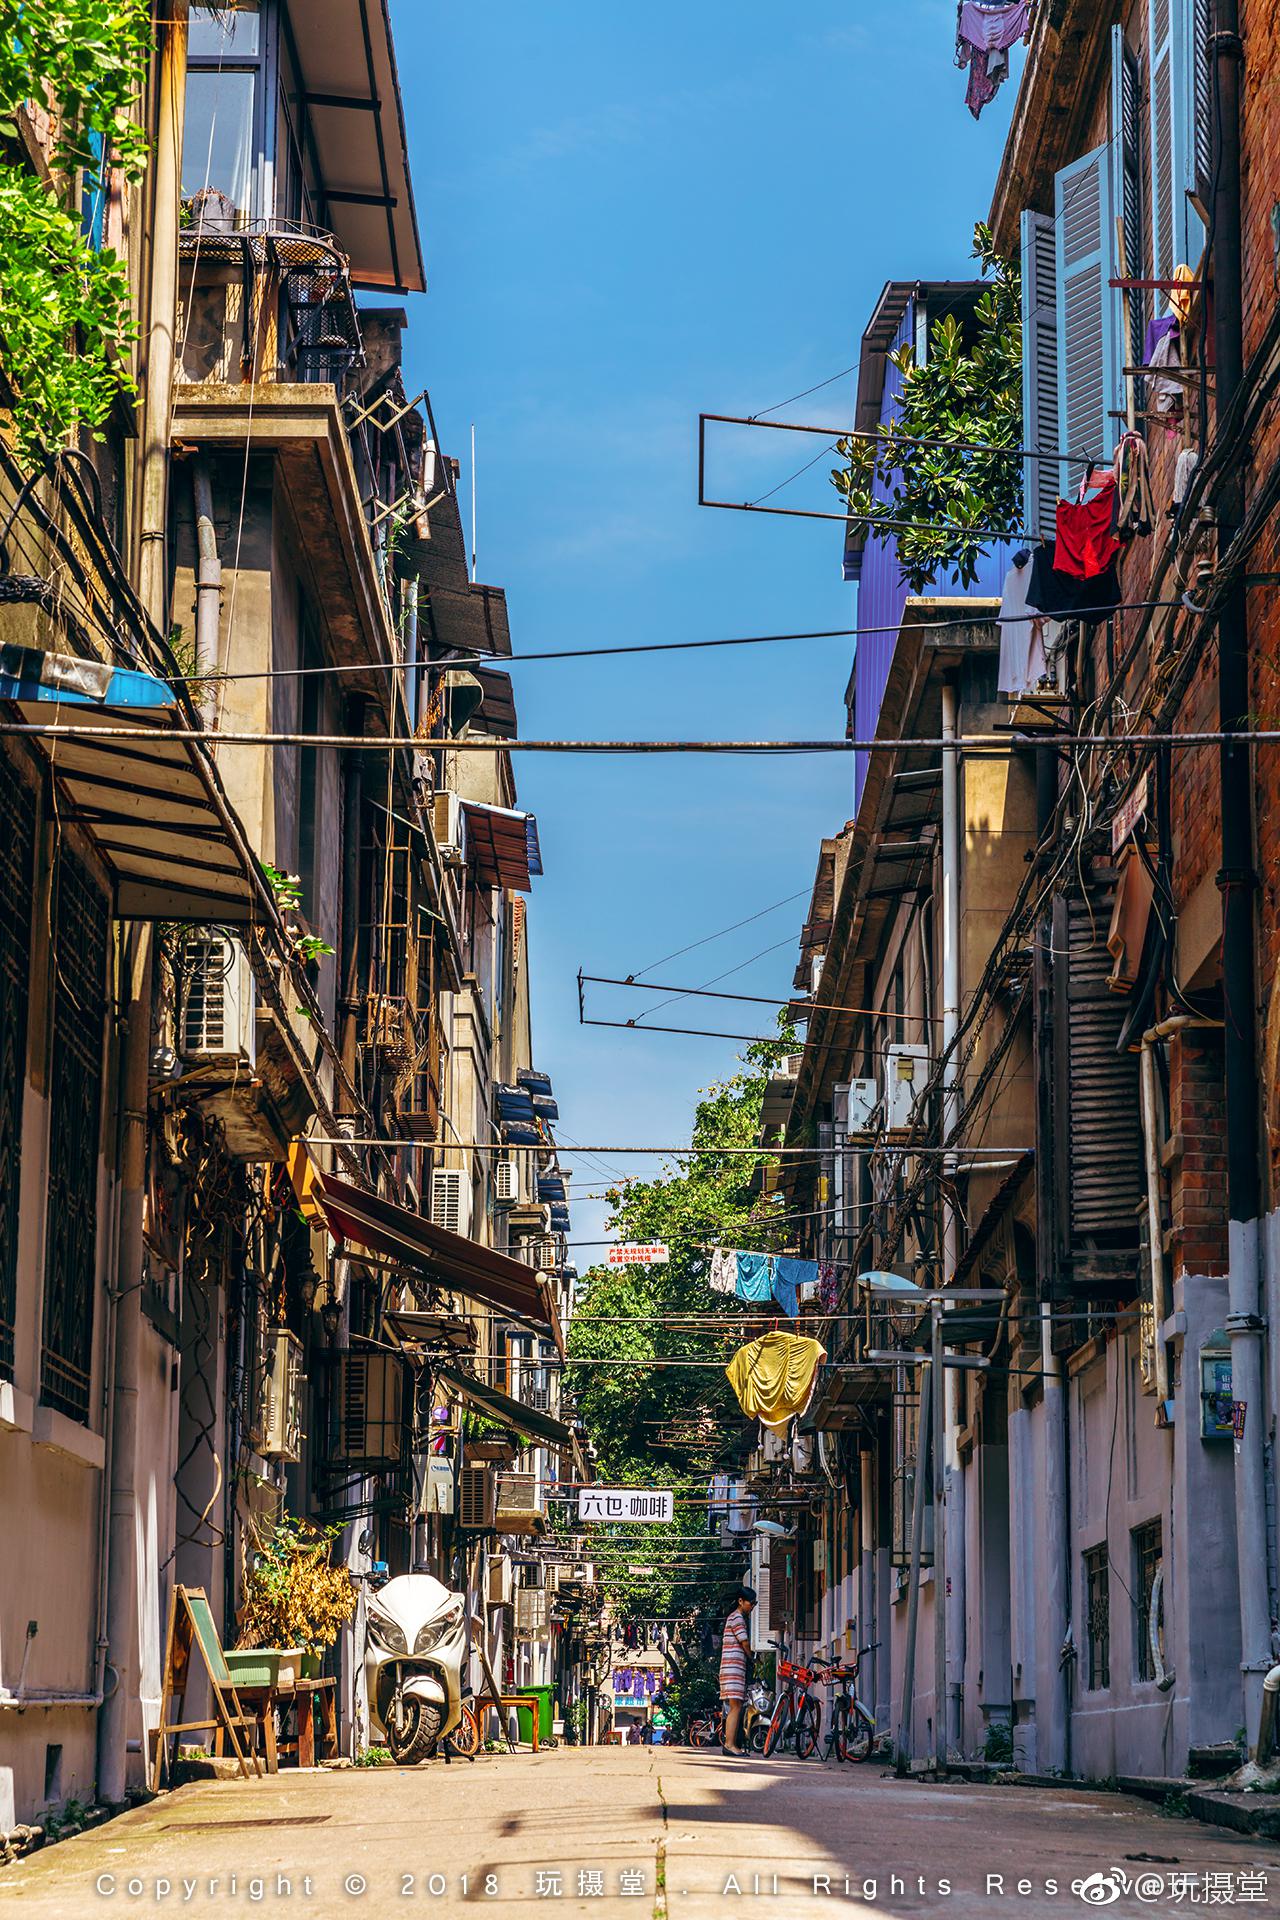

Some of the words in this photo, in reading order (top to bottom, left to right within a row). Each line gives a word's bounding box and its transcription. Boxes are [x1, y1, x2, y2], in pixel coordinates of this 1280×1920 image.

[609, 1247, 666, 1255] 严禁无规划无审批
[609, 1255, 652, 1263] 设置空中线缆
